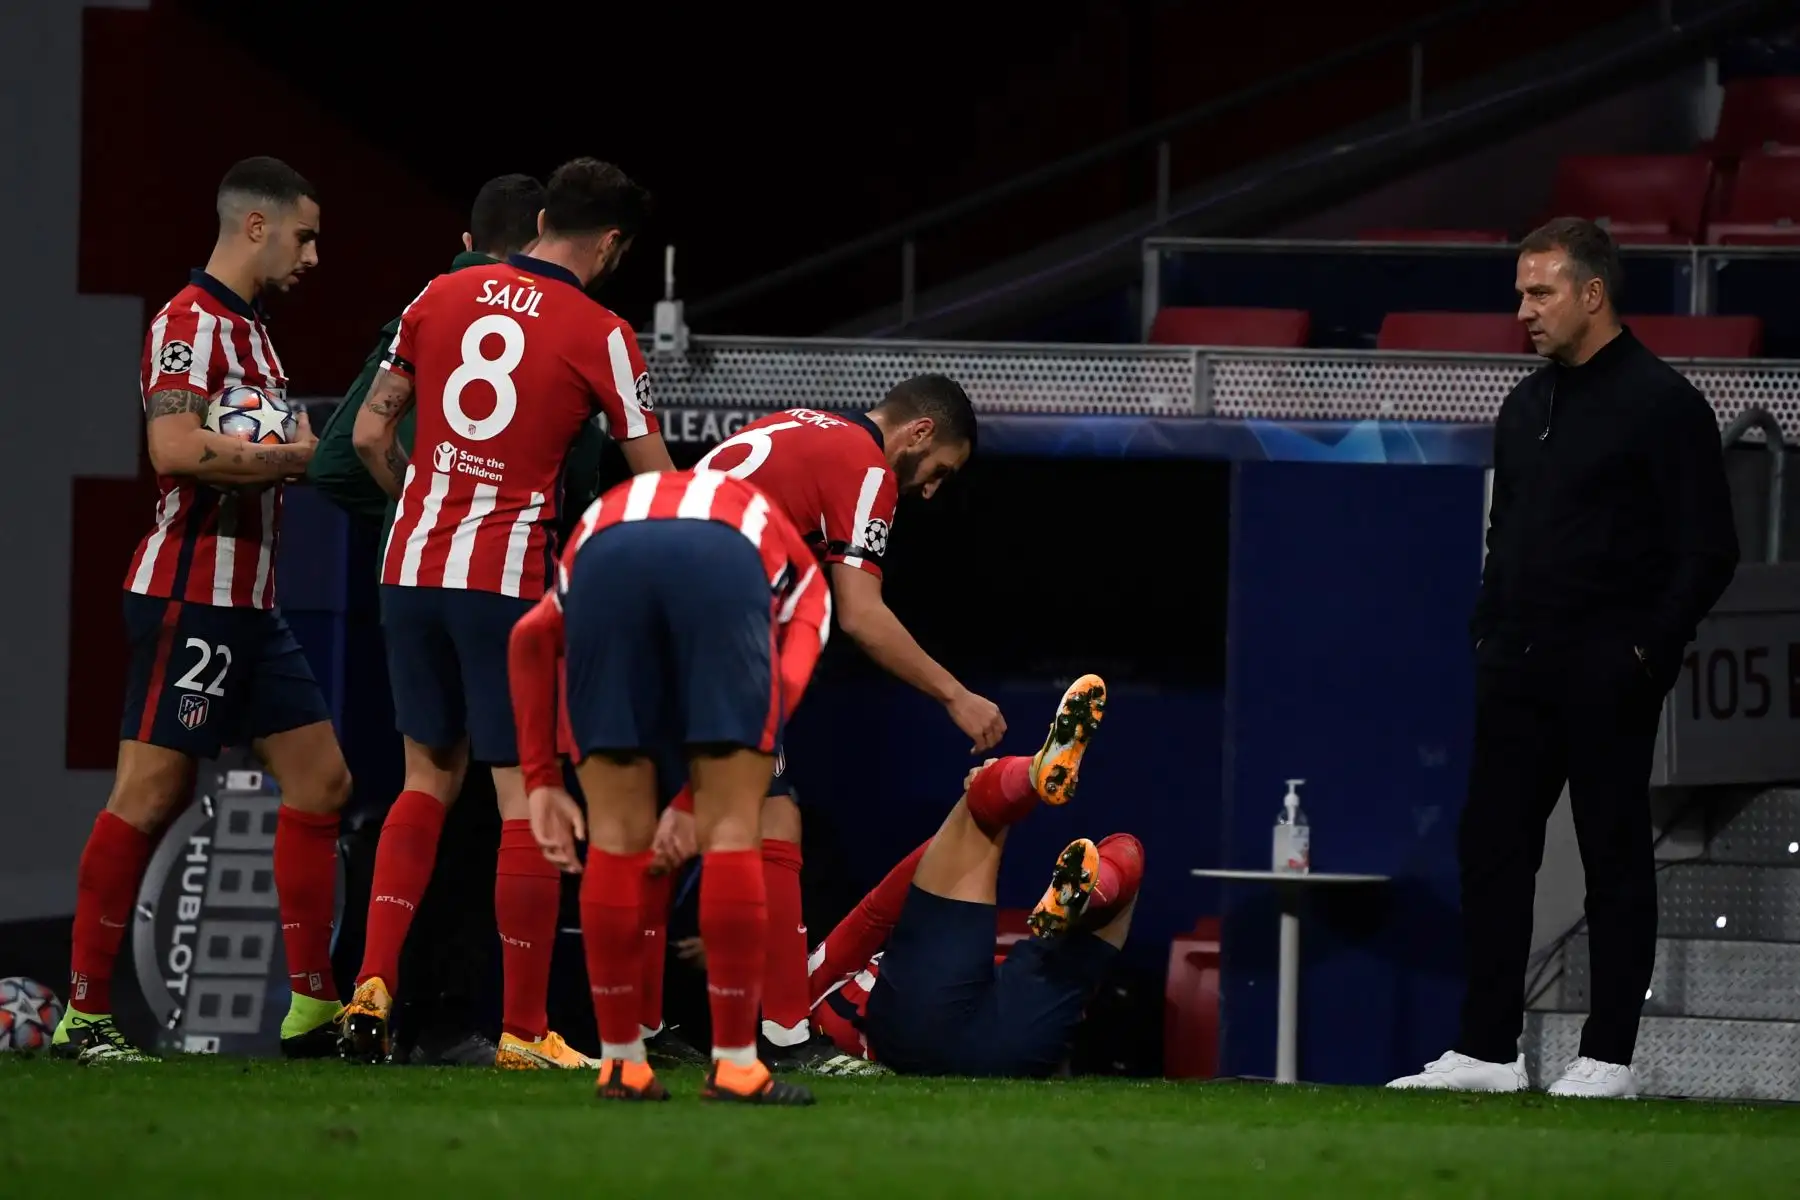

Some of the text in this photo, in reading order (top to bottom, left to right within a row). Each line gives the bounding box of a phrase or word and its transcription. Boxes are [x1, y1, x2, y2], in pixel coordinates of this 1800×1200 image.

[476, 279, 543, 318] SAÚL
[442, 314, 525, 441] 8
[664, 409, 764, 443] LEAG
[457, 462, 503, 482] Children
[459, 450, 505, 470] Save the
[173, 637, 232, 697] 22
[1683, 646, 1771, 721] 105
[165, 836, 211, 996] HUBLOT
[376, 895, 415, 911] ATLETI
[498, 931, 533, 949] TLETI
